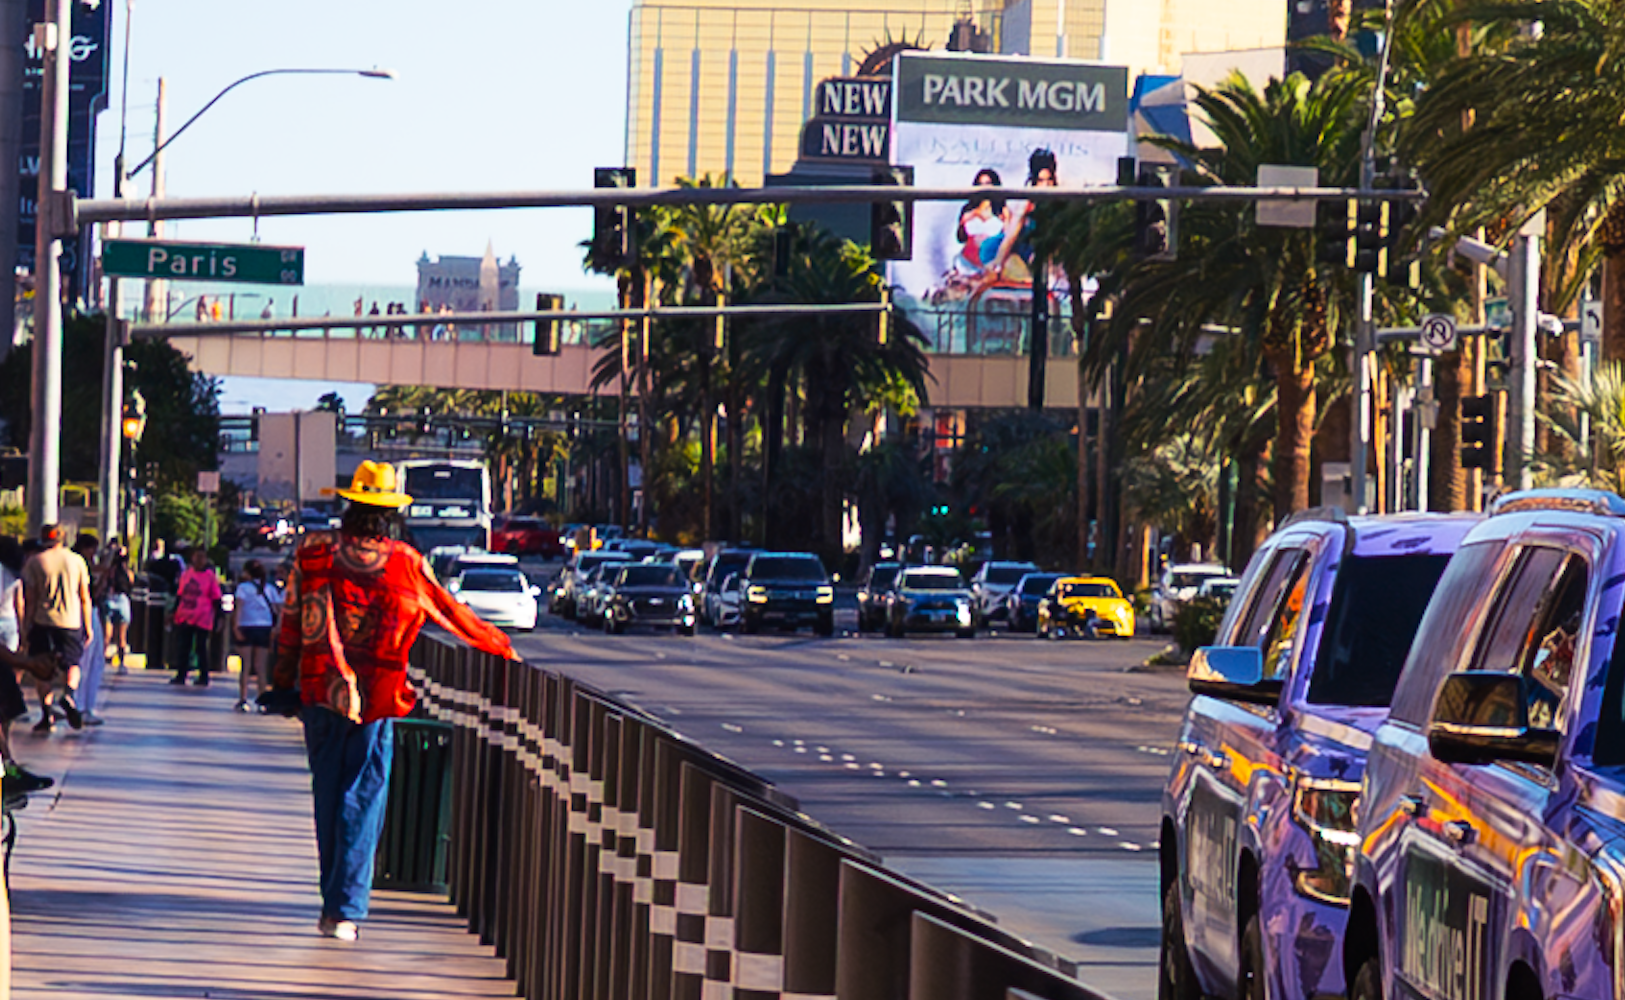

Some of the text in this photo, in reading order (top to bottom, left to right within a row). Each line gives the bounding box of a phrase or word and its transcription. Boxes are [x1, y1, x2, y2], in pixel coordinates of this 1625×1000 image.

[823, 81, 889, 117] NEW
[923, 74, 1107, 113] PARK MGM
[821, 122, 887, 157] NEW
[147, 247, 237, 277] Paris
